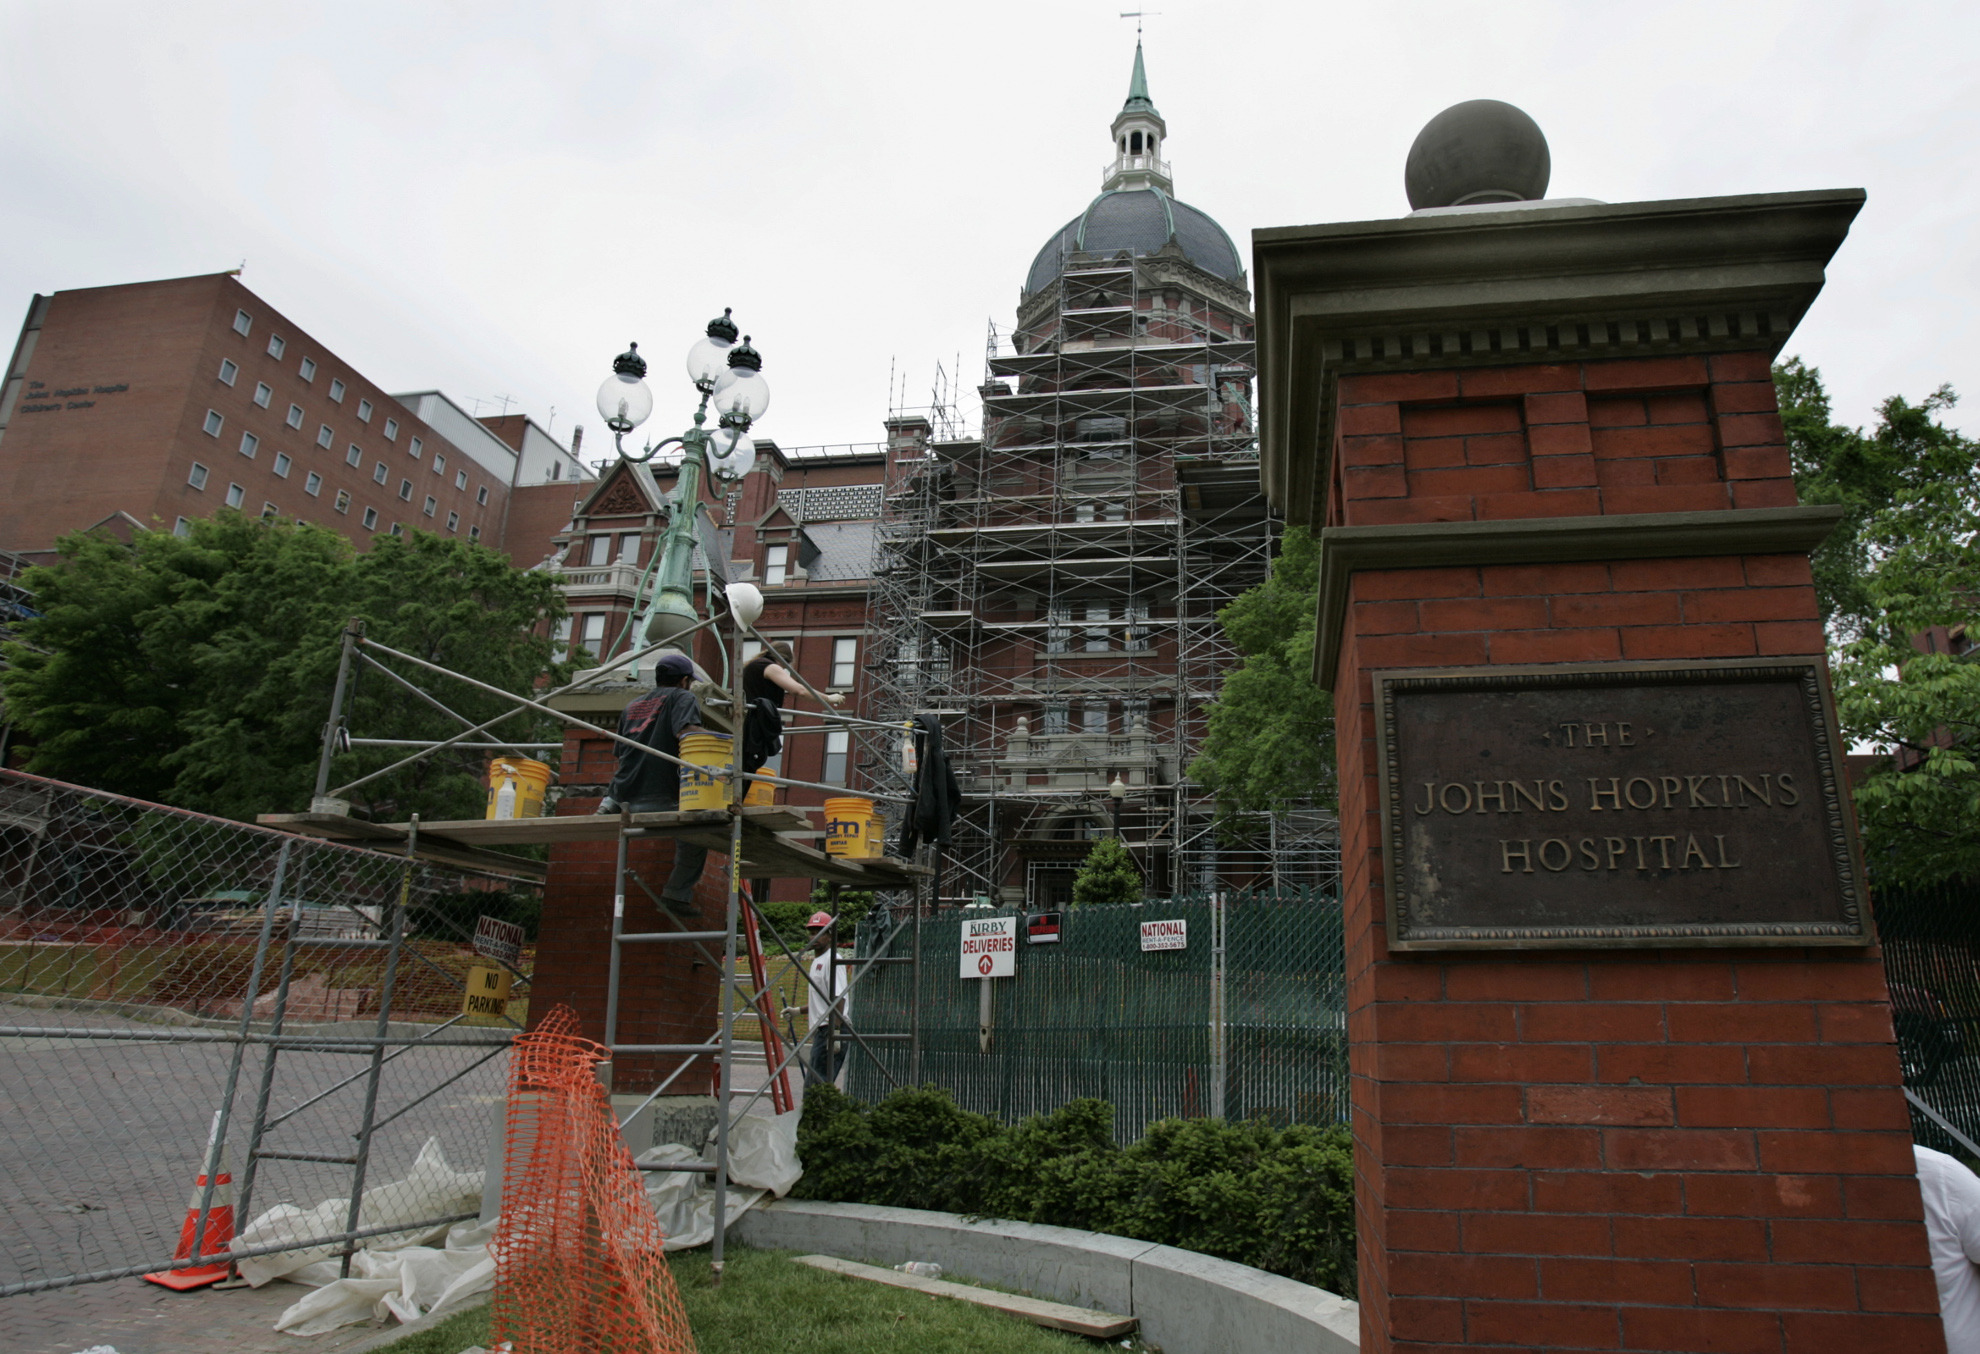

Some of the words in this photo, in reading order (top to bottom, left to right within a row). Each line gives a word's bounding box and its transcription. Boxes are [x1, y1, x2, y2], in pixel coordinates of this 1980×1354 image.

[1559, 722, 1637, 748] THE
[1415, 779, 1570, 816] JOHNS
[1587, 773, 1800, 812] HOPKINS
[1500, 833, 1742, 873] HOSPITAL
[477, 918, 522, 947] NATIONAL
[970, 921, 1007, 935] KIRBY
[1142, 922, 1184, 937] NATIONAL
[963, 937, 1013, 954] DELIVERIES
[484, 973, 499, 990] NO
[467, 995, 504, 1015] PARKING
